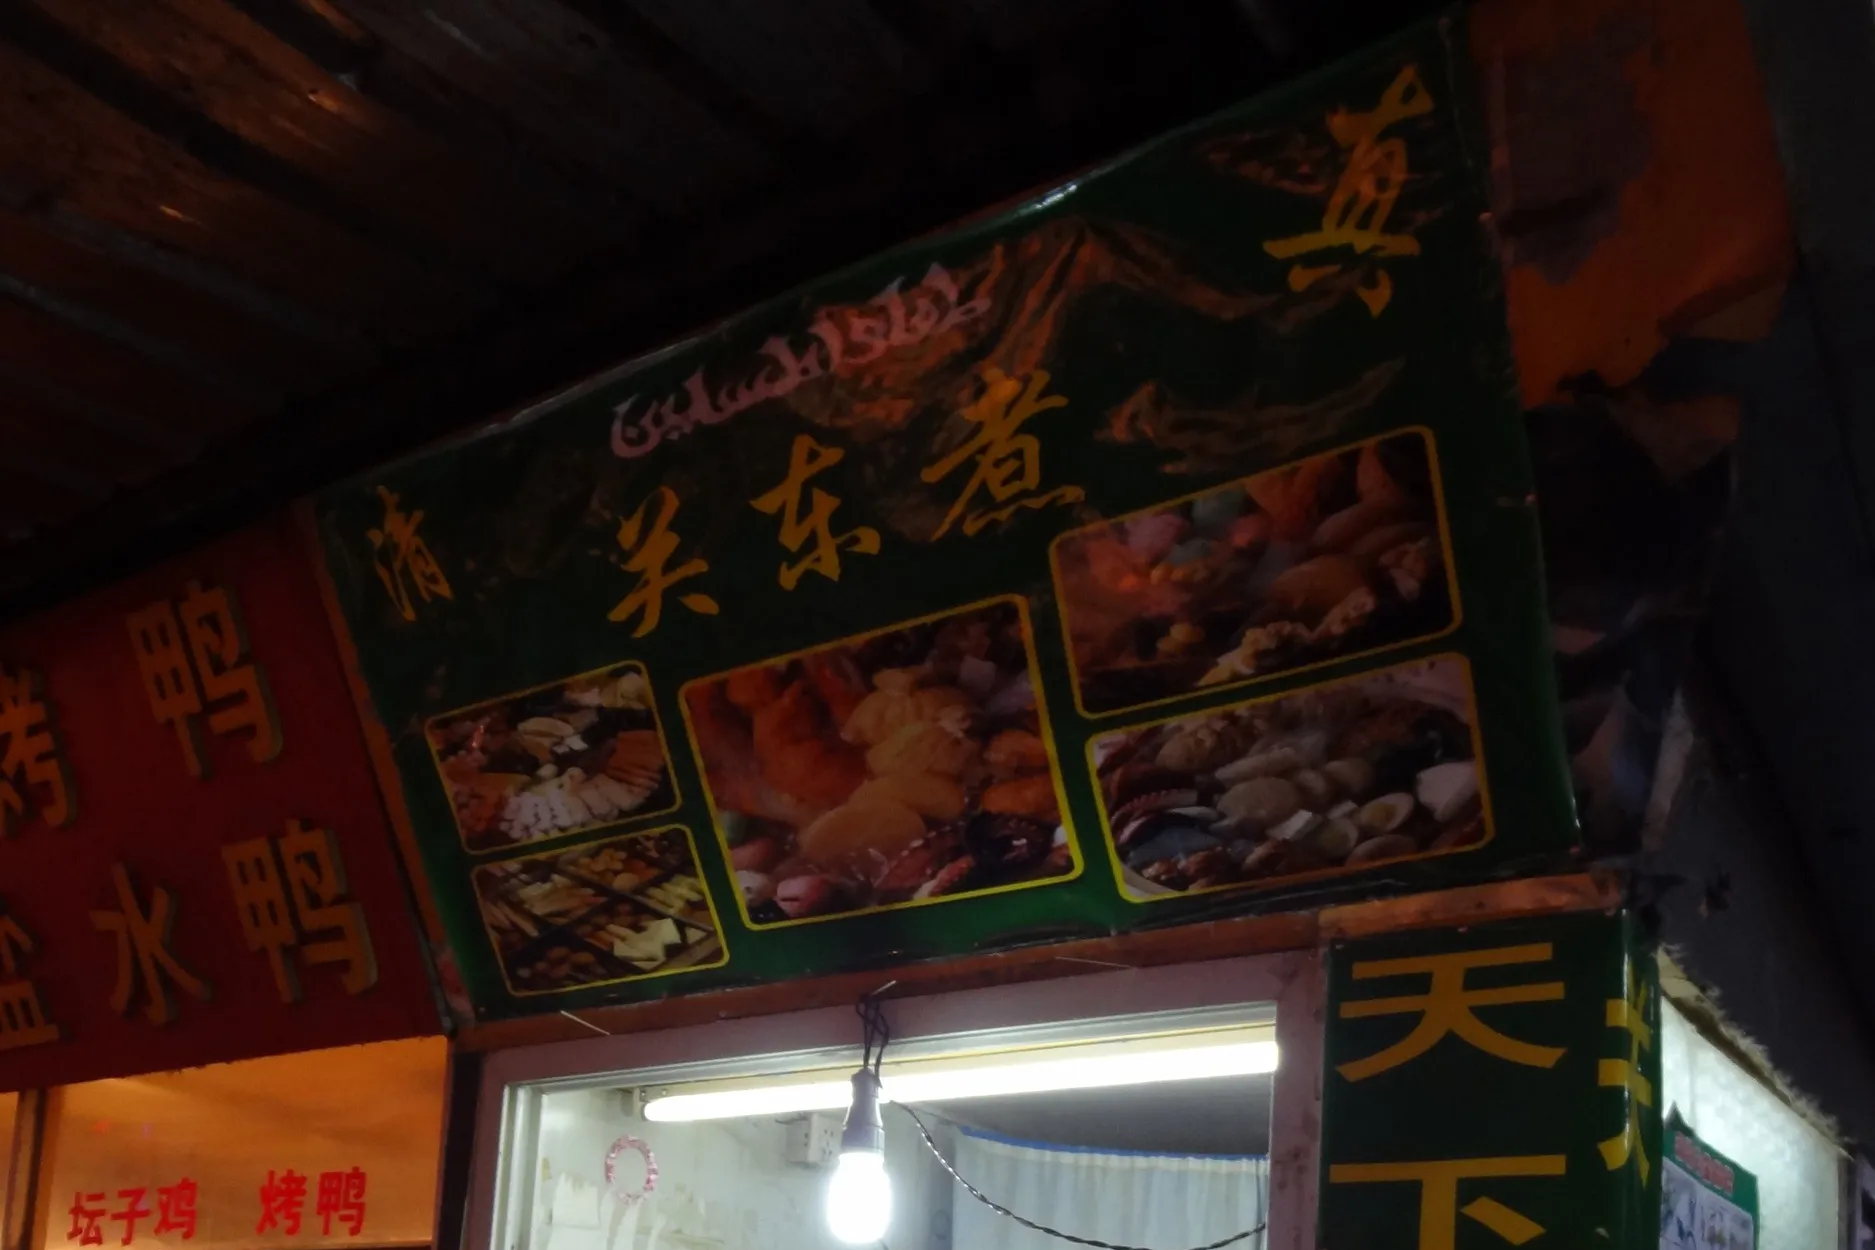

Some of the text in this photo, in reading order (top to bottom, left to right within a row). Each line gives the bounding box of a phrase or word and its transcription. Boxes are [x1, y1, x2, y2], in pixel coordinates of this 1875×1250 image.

[366, 485, 455, 622] 清
[606, 367, 1086, 639] 关东煮
[67, 1166, 367, 1246] 坛子鸡 烤鸭
